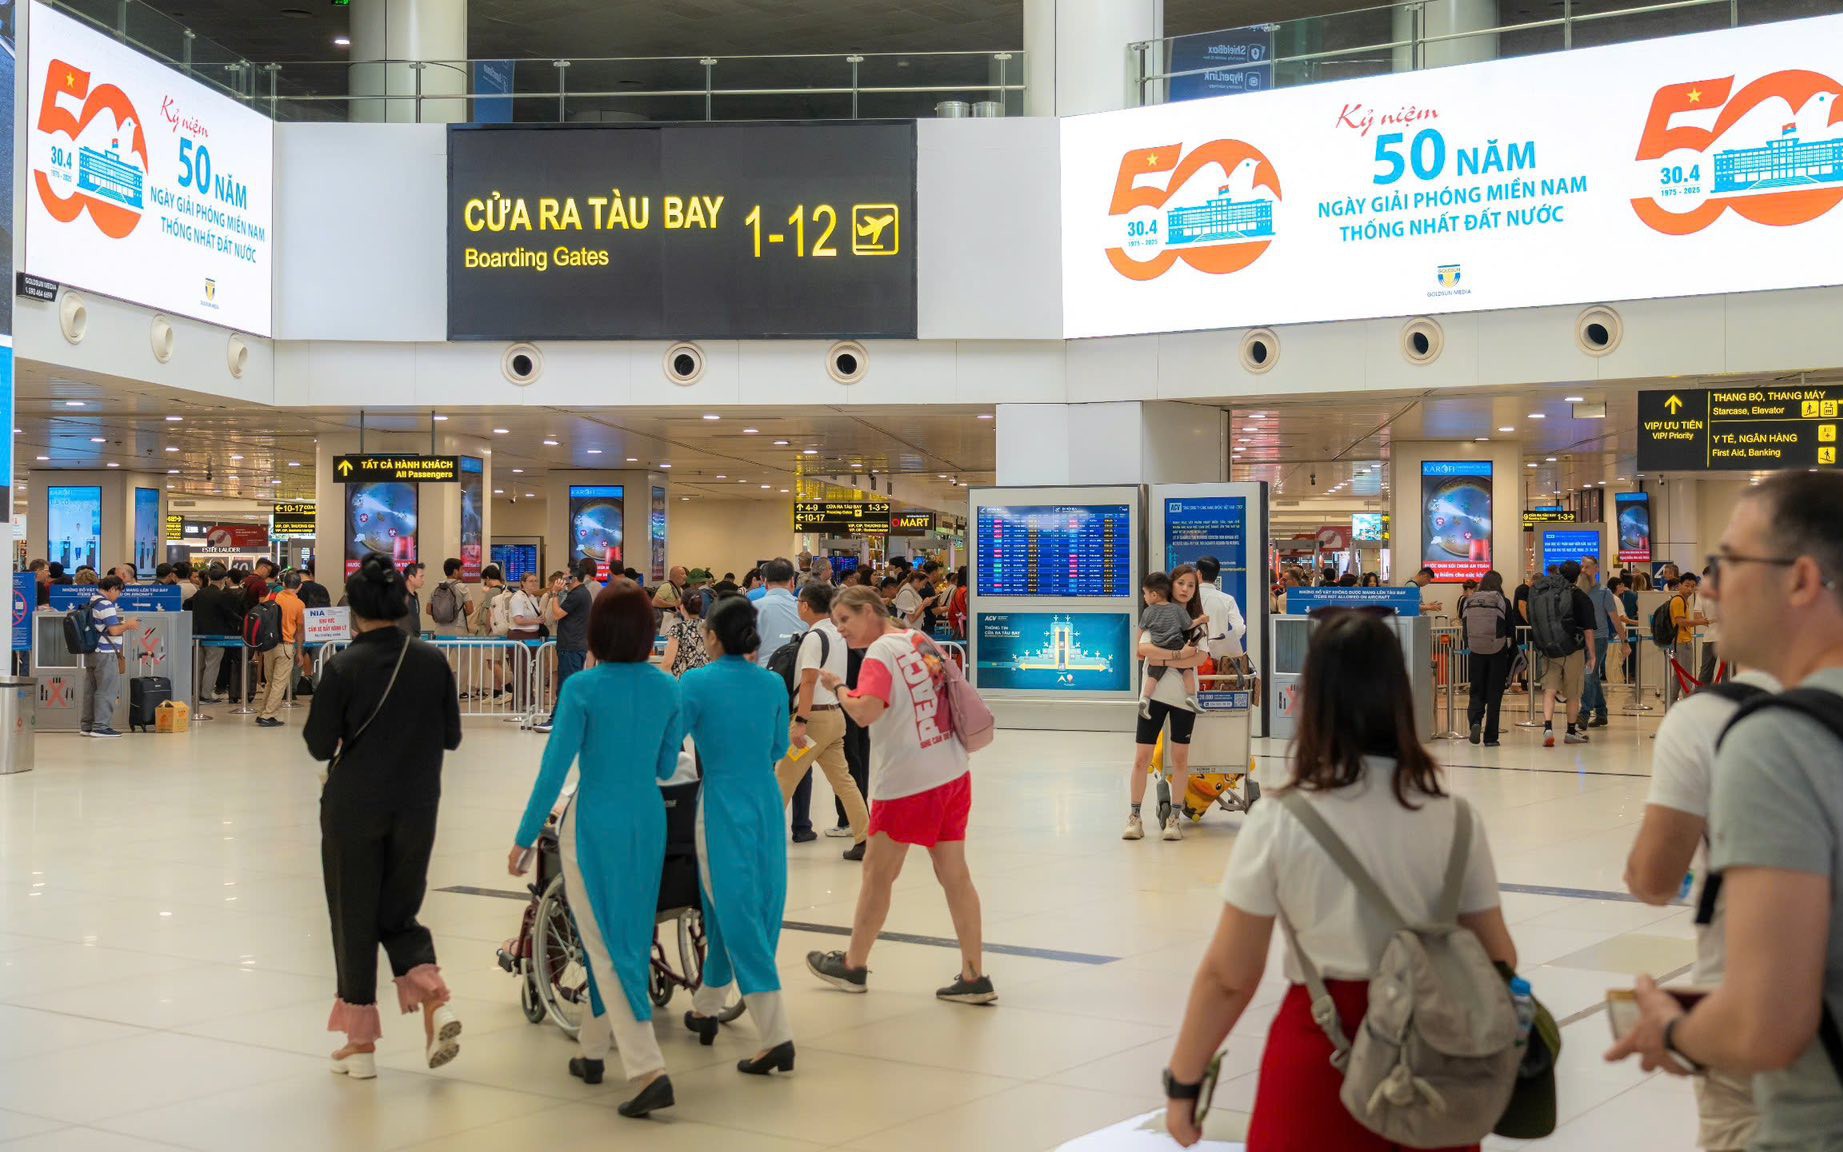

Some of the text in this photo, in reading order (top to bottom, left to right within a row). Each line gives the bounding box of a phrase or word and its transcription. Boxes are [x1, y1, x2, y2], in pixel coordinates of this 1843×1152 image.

[160, 95, 208, 138] Kỷ niệm
[1336, 103, 1440, 137] Kỷ niệm
[50, 145, 72, 170] 30.4
[1373, 128, 1536, 185] 50 NĂM
[178, 136, 247, 210] 50 NĂM
[1660, 164, 1700, 186] 30.4
[1318, 175, 1587, 218] NGÀY GIẢI PHÓNG MIỀN NAM
[1661, 188, 1677, 197] 1975
[1684, 186, 1700, 195] 2025
[150, 185, 265, 241] NGÀY GIẢI PHÓNG MIỀN NAM
[464, 188, 725, 233] CỬA RA TÀU BAY
[745, 204, 838, 258] 1-12
[1127, 219, 1158, 237] 30.4
[1340, 204, 1564, 242] THỐNG NHẤT ĐẤT NƯỚC
[161, 216, 256, 263] THỐNG NHẤT ĐẤT NƯỚC
[464, 245, 609, 272] Boarding Gates
[1713, 389, 1826, 403] THANG BỘ, THANG MÁY
[1713, 406, 1785, 416] Starcase, Elevator
[1644, 418, 1703, 430] VIP/ ƯU TIÊN
[1652, 431, 1694, 441] VIP/ Priority
[1712, 432, 1798, 444] Y TẾ, NGÂN HÀNG
[1712, 448, 1781, 458] First Aid, Banking
[361, 458, 453, 469] TẤT CẢ HÀNH KHÁCH
[396, 470, 453, 479] All Passengers
[283, 504, 304, 513] 10-17
[805, 503, 818, 512] 4-9
[868, 503, 881, 511] 1-3
[804, 514, 825, 522] 10-17
